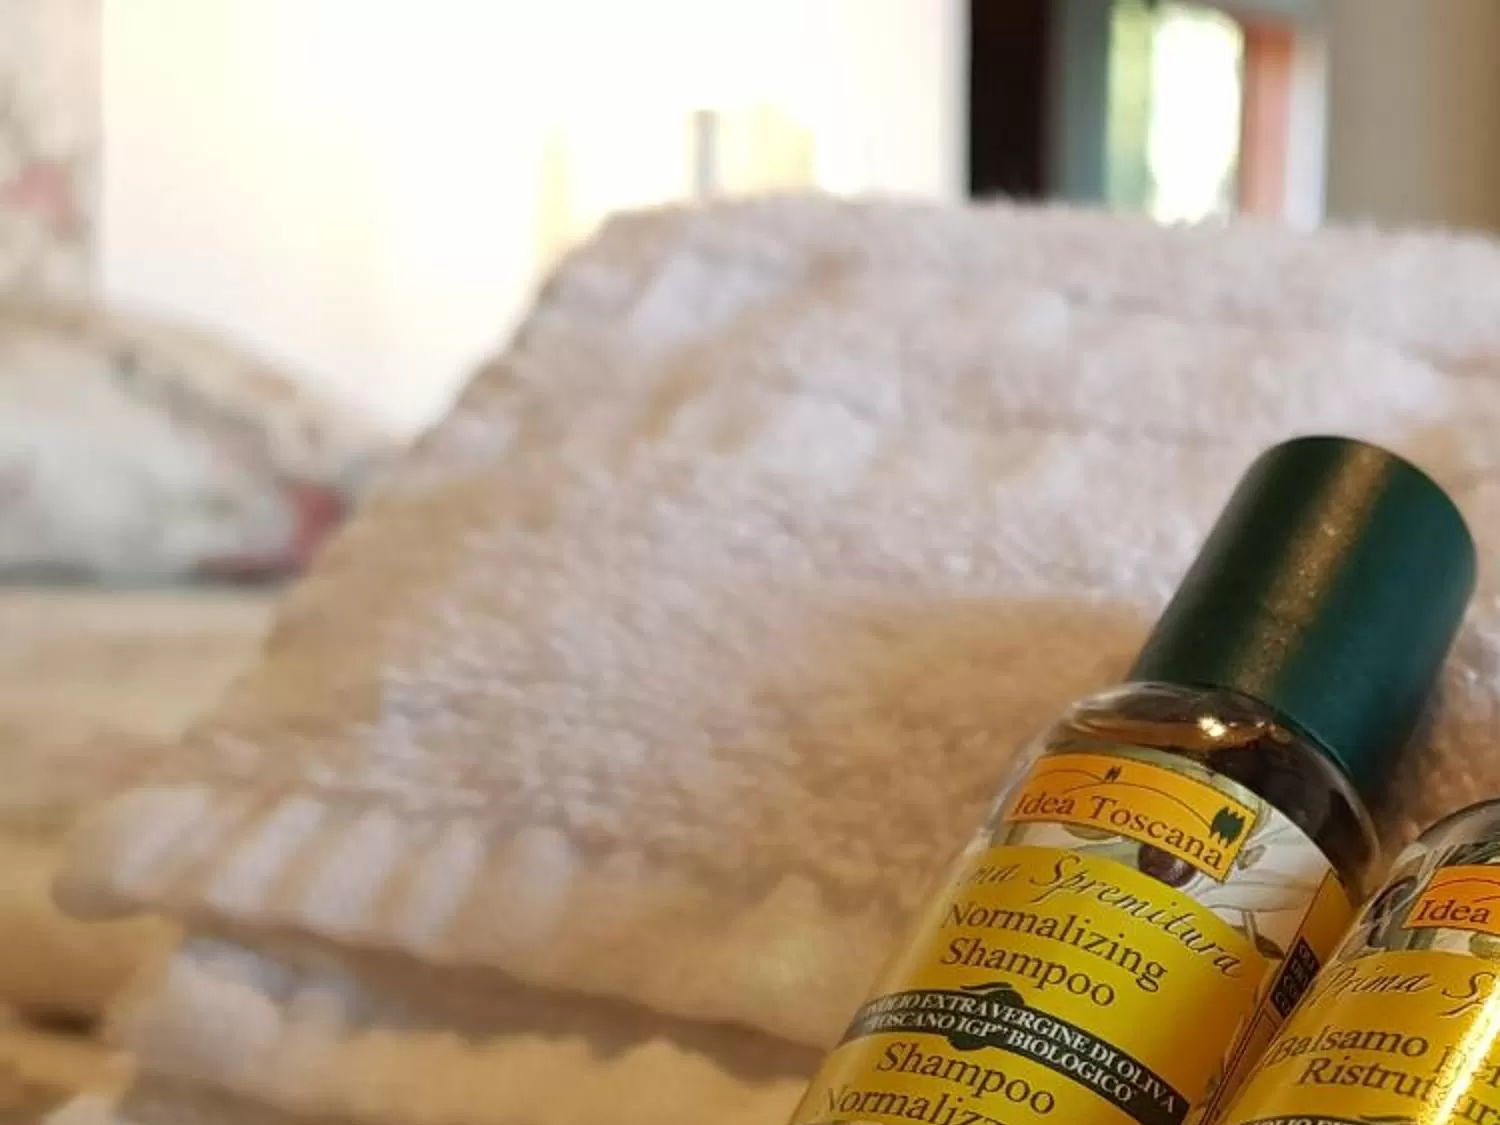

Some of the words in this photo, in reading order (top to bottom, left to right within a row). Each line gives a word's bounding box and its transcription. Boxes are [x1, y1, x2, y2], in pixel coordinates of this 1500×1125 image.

[1012, 791, 1076, 817] Idea
[1088, 795, 1224, 872] Toscana
[942, 902, 1169, 994] Normalizing
[1029, 854, 1242, 978] Spremitura
[1414, 899, 1491, 925] Idea
[941, 936, 1117, 1008] Shampoo
[875, 1040, 1056, 1116] Shampoo
[920, 992, 1091, 1054] EXTRAVERGINE
[1088, 1042, 1118, 1068] DI
[1116, 1059, 1176, 1114] OLIVA
